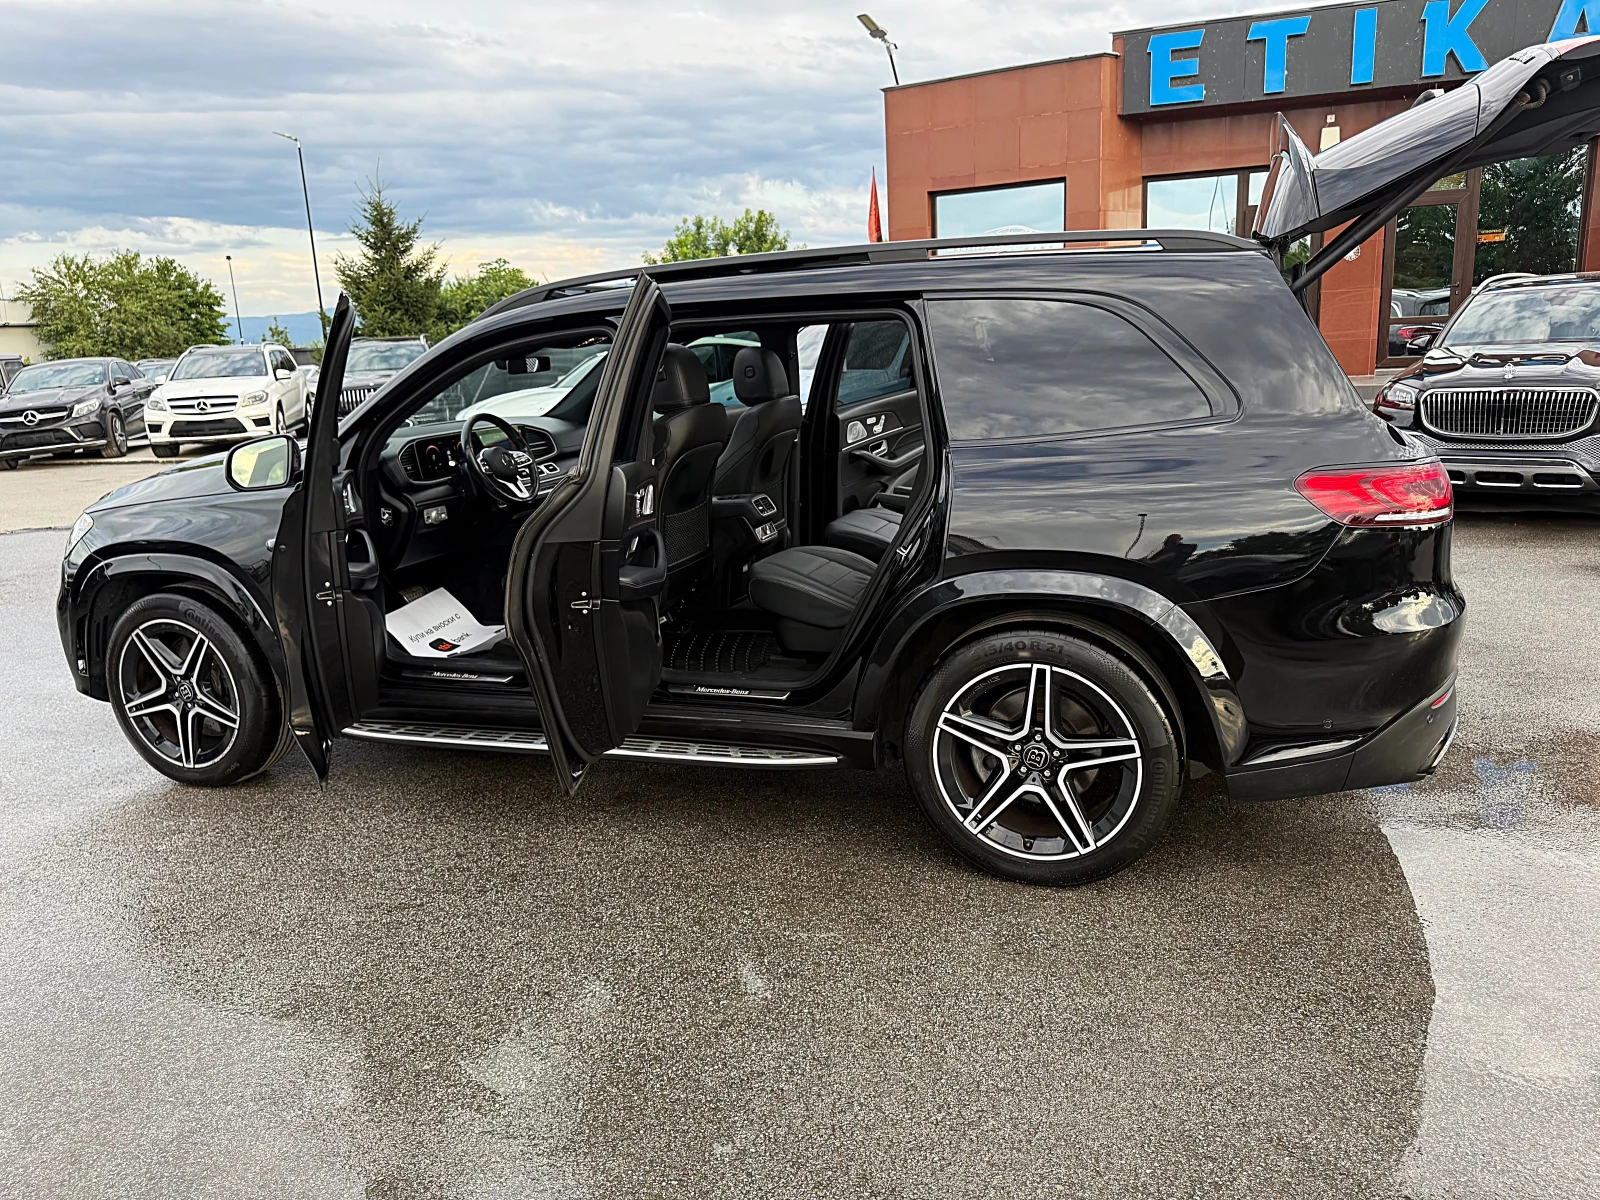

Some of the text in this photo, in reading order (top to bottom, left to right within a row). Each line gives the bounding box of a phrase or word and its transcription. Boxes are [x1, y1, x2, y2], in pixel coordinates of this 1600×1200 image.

[408, 632, 426, 643] Купи
[425, 628, 435, 637] на
[434, 617, 455, 632] вноски
[973, 641, 1027, 661] 15/40
[696, 686, 750, 695] Mercedes-Benz
